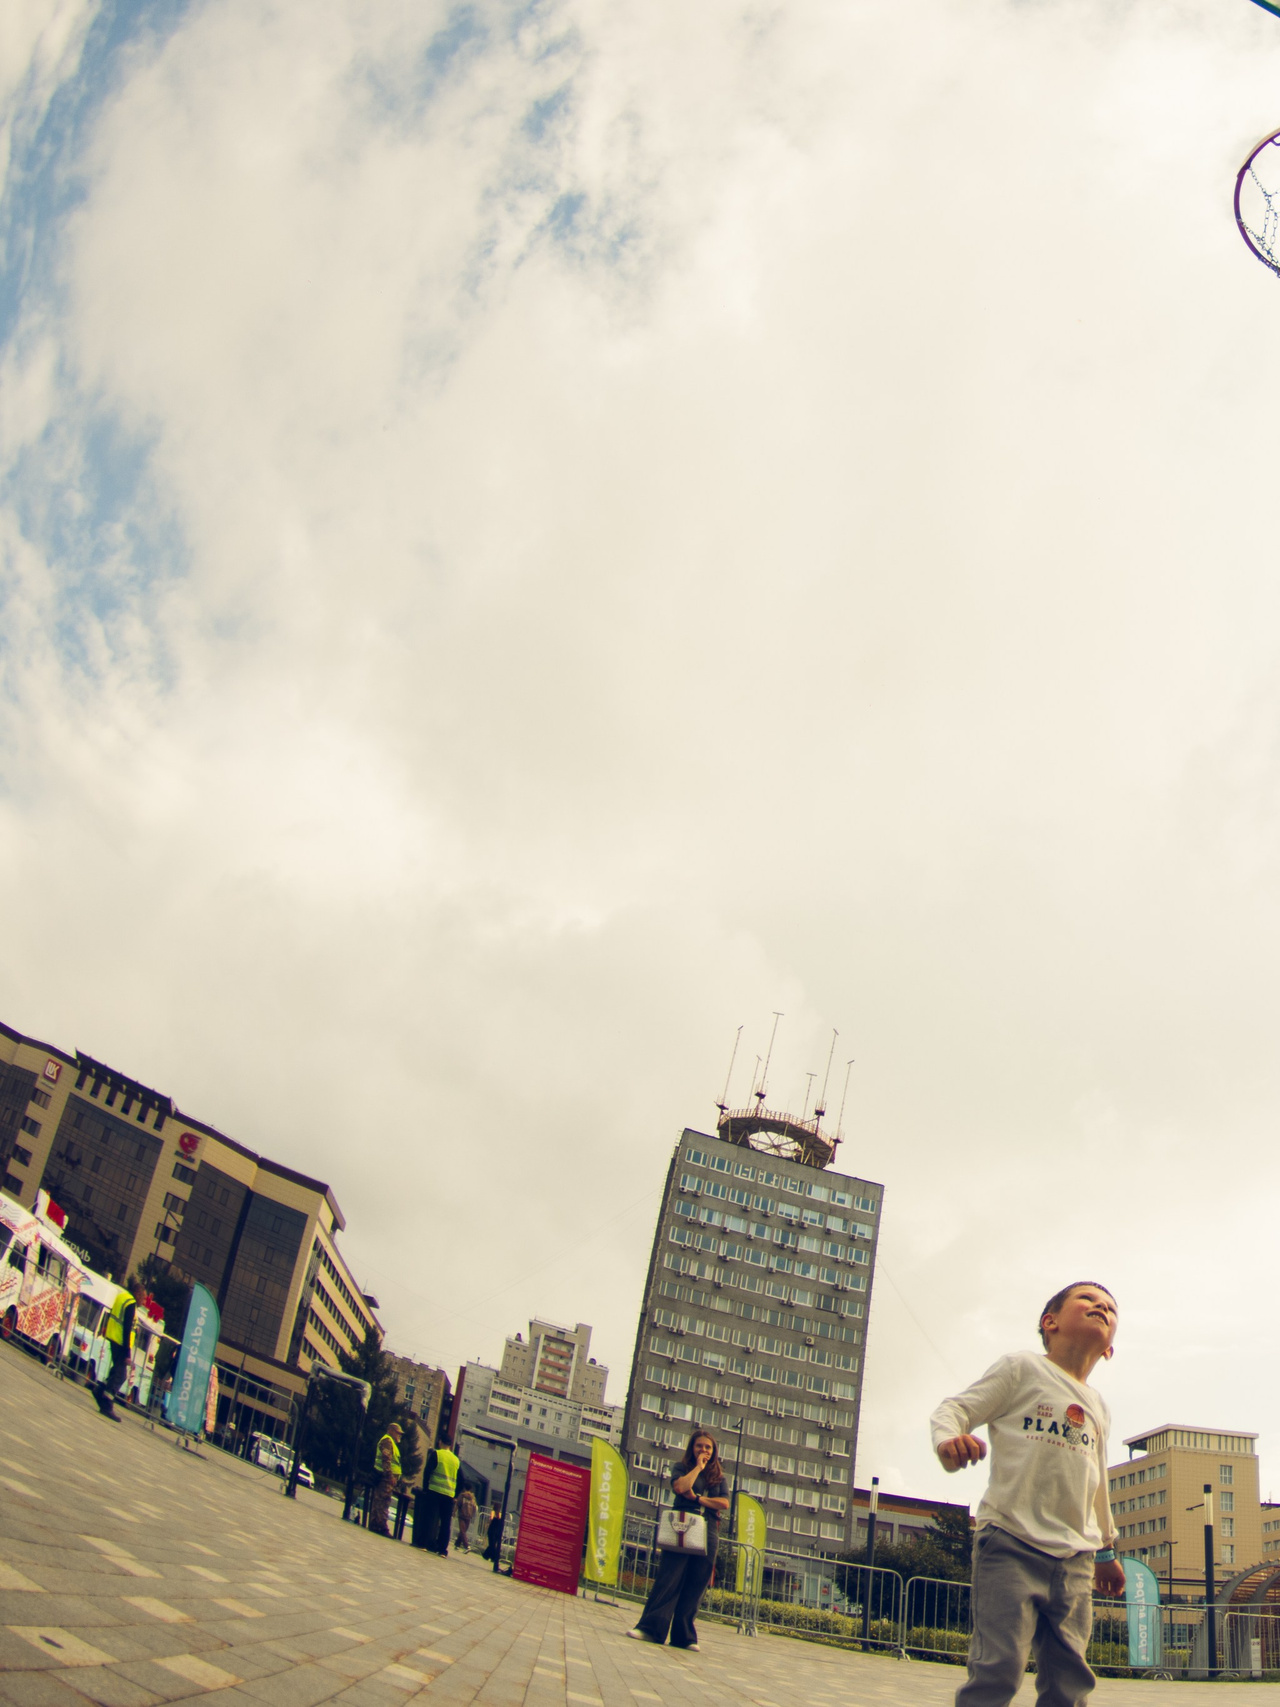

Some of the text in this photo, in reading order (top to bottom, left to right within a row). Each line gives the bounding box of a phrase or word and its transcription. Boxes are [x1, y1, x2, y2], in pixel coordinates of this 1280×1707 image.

[1037, 1404, 1054, 1412] PLAY
[1023, 1416, 1070, 1437] PLAY
[1047, 1439, 1065, 1448] GAME
